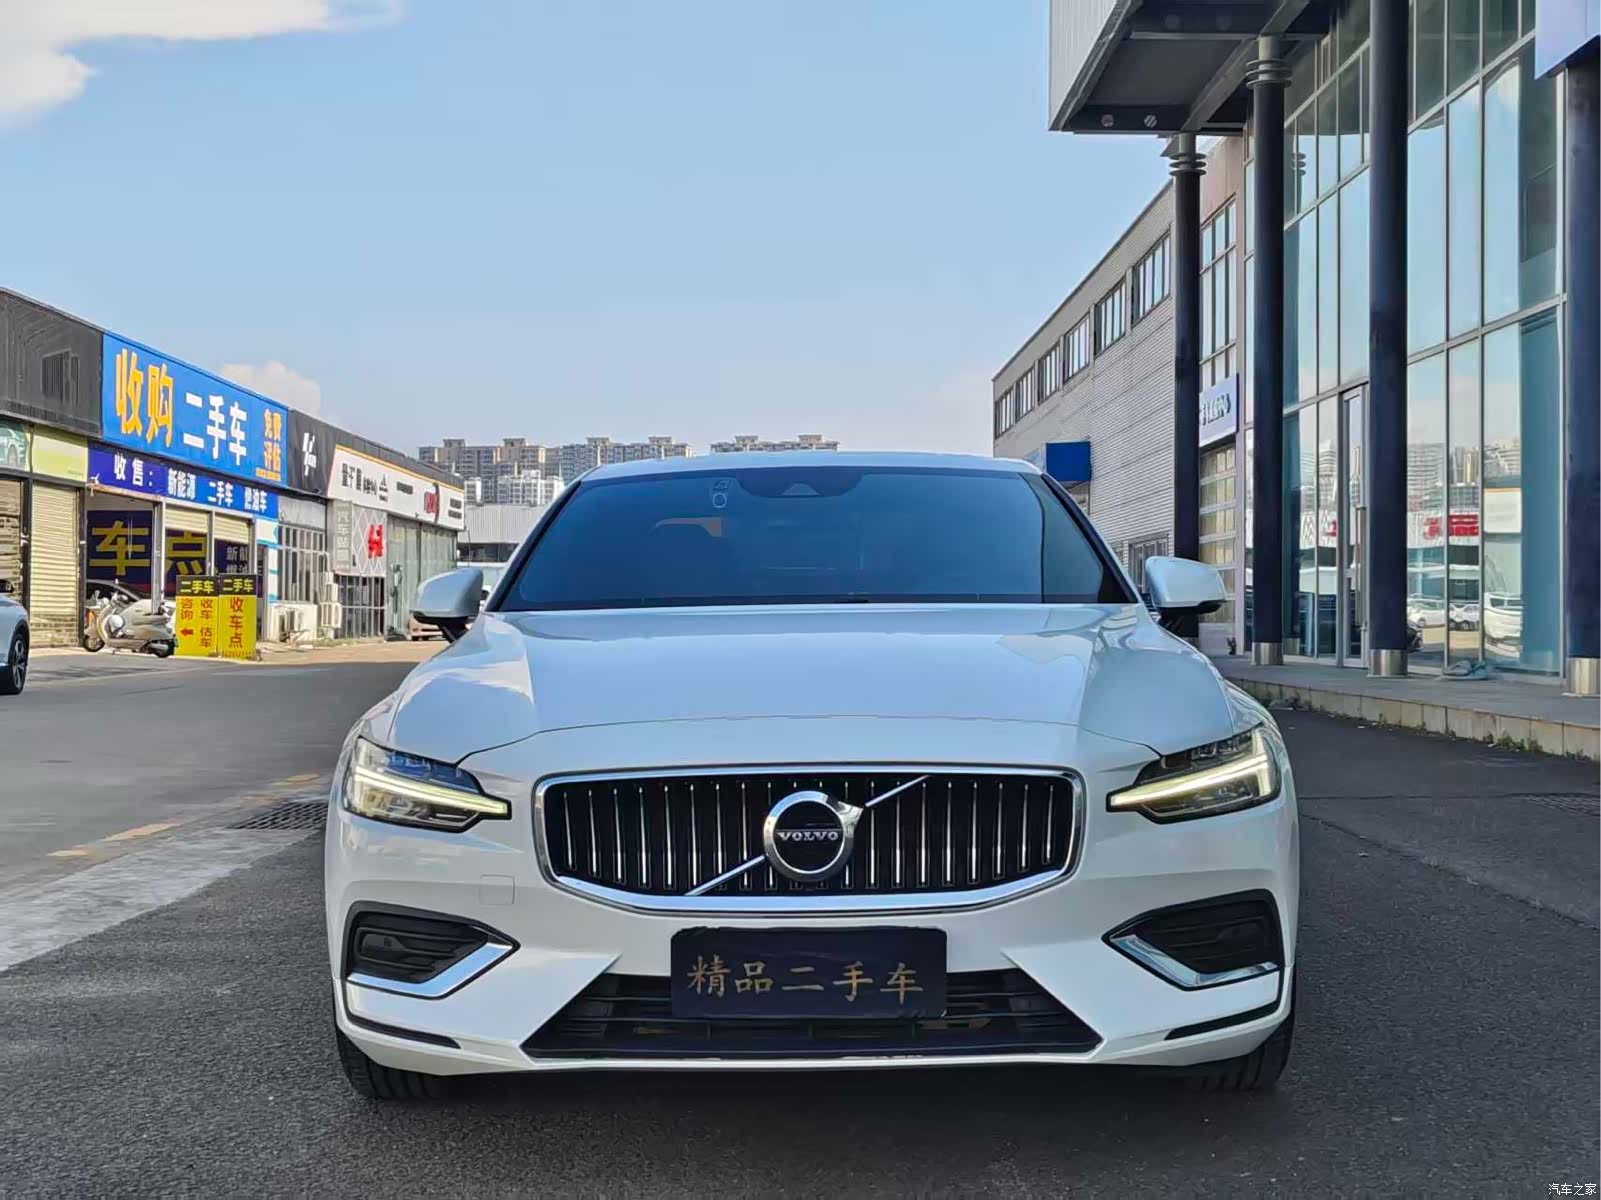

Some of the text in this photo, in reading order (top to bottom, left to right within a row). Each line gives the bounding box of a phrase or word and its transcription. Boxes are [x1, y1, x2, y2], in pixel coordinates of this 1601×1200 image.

[115, 348, 174, 448] 收购
[183, 393, 247, 465] 二手车
[168, 468, 196, 500] 新能源
[207, 480, 233, 507] 二手车
[180, 581, 214, 594] 二手车
[223, 578, 253, 592] 二手车
[181, 598, 193, 620] 咨询
[230, 597, 244, 648] 收车点
[776, 830, 840, 842] VOLVO
[687, 954, 924, 1005] 精品二手车
